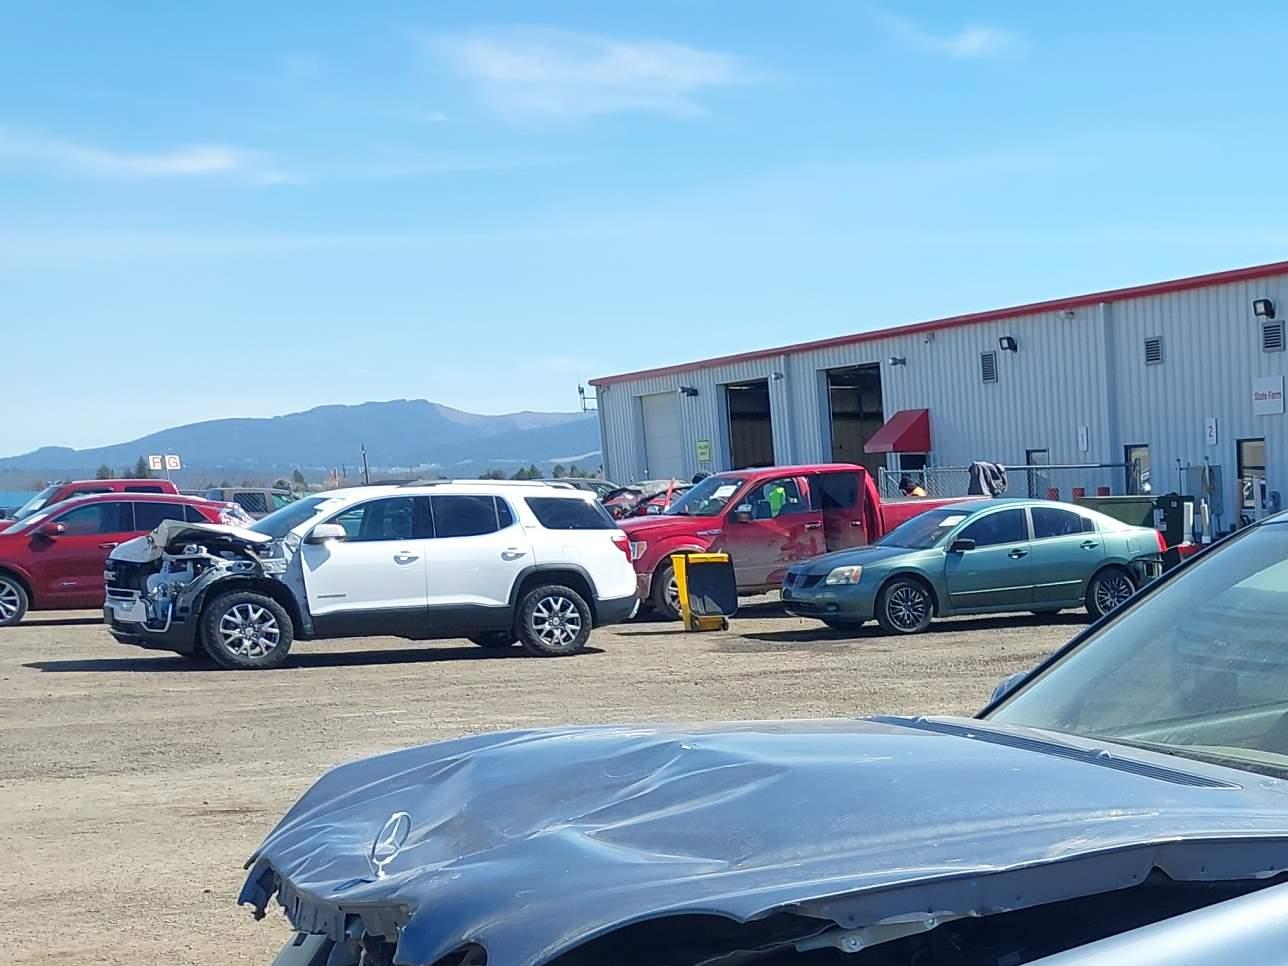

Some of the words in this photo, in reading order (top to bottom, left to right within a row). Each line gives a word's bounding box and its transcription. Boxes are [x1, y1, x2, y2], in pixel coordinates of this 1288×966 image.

[1208, 426, 1214, 438] 2
[152, 457, 160, 468] F
[168, 457, 179, 468] G
